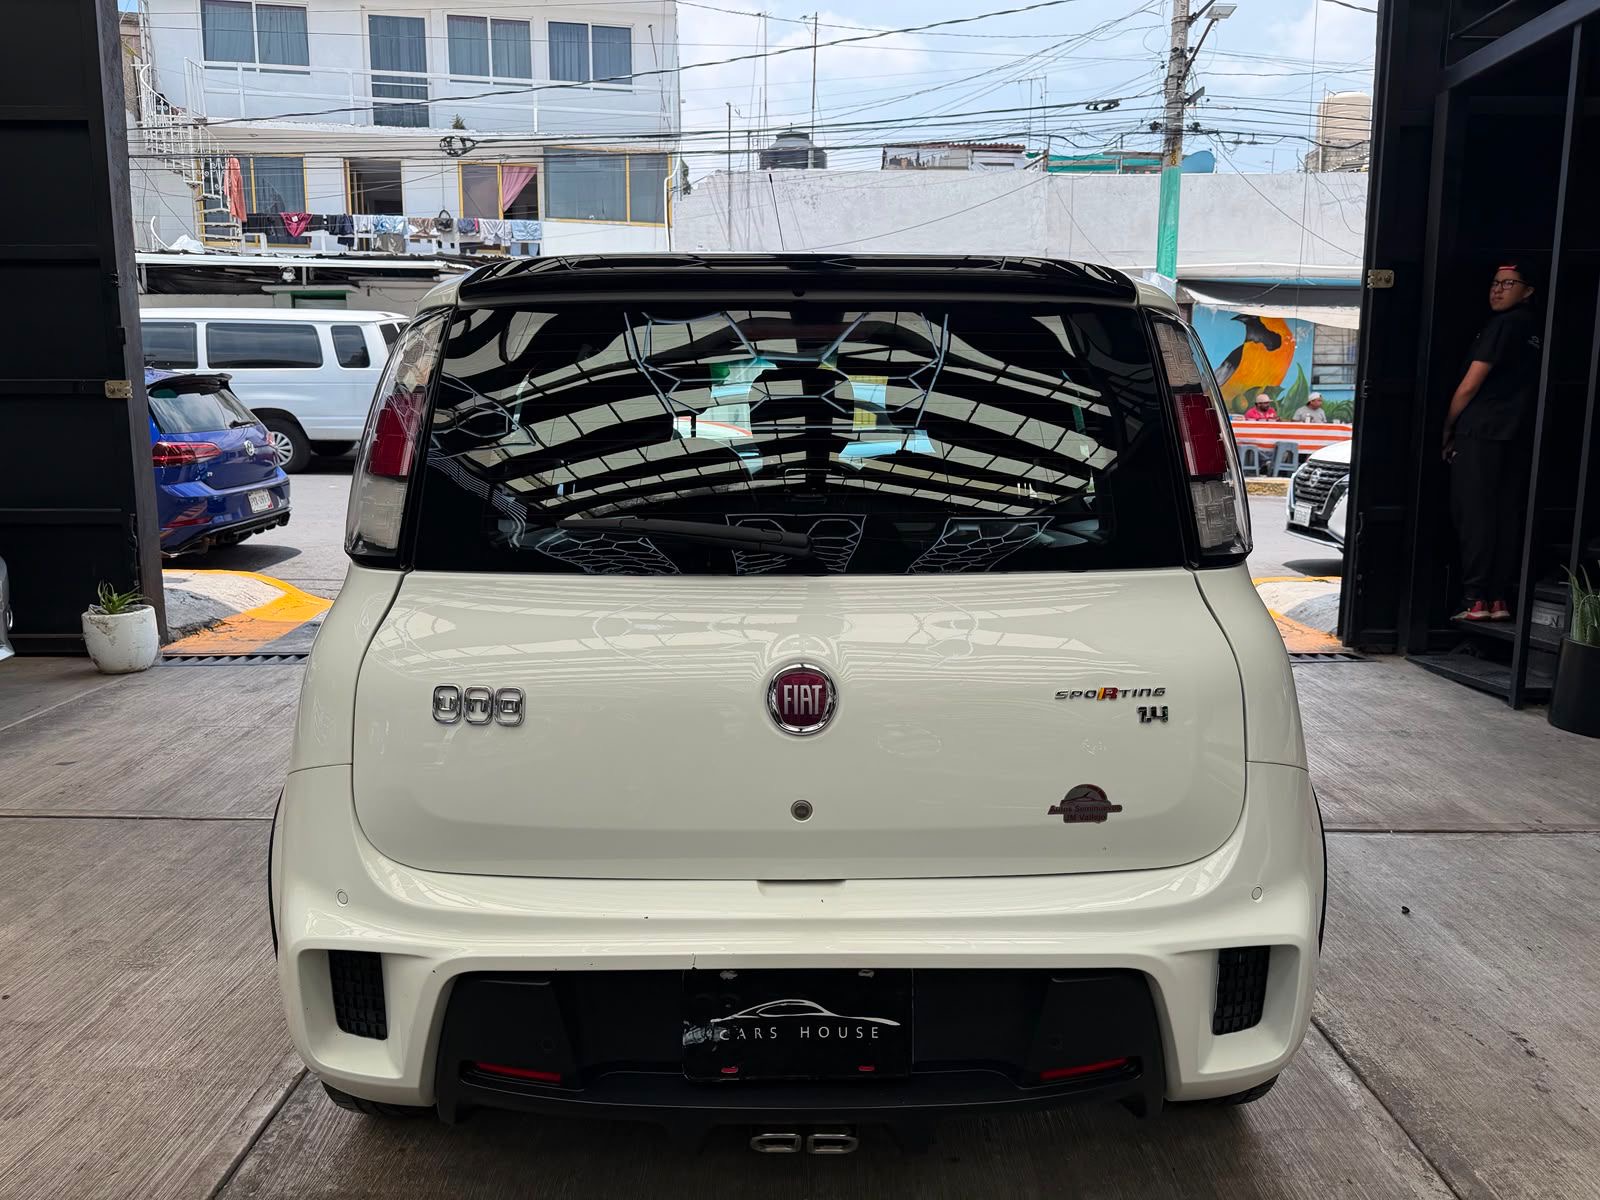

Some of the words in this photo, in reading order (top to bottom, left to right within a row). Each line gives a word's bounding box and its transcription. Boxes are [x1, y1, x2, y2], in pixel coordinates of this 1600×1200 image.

[783, 684, 823, 715] FIAT
[1054, 687, 1166, 701] SPORTING
[1137, 705, 1169, 723] 1.4
[719, 1026, 778, 1041] CARS
[799, 1026, 879, 1039] HOUSE
